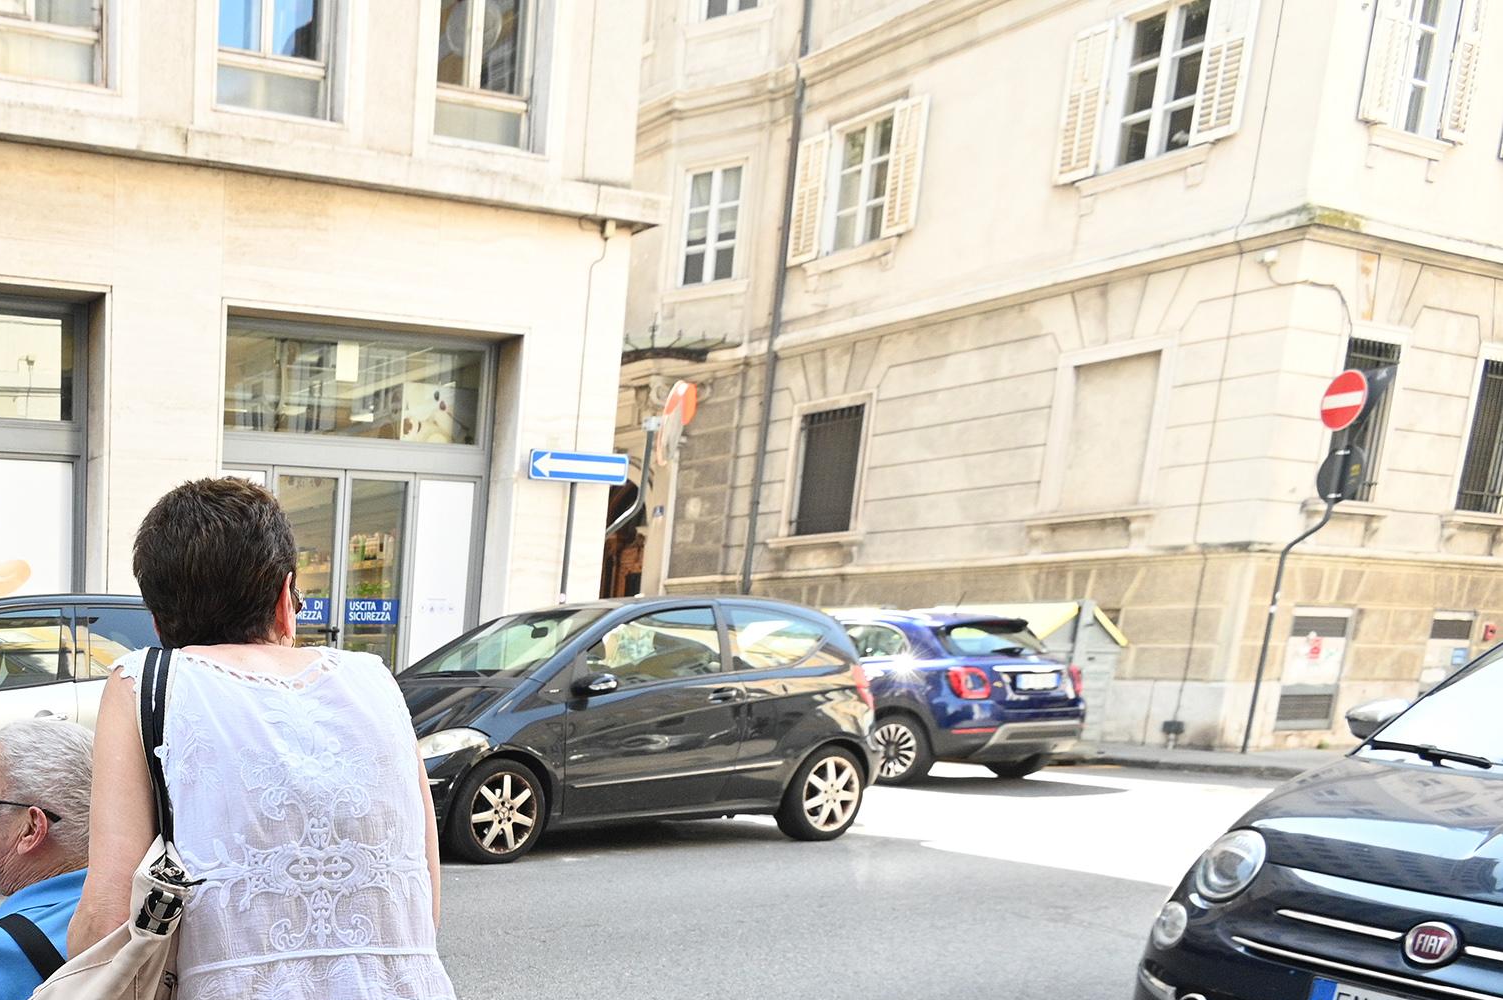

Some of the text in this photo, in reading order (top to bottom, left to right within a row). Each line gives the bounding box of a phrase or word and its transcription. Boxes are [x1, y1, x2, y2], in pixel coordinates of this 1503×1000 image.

[314, 600, 323, 610] DI
[349, 600, 392, 612] USCITA DI
[348, 611, 391, 622] SICUREZZA
[1413, 933, 1448, 955] FIAT
